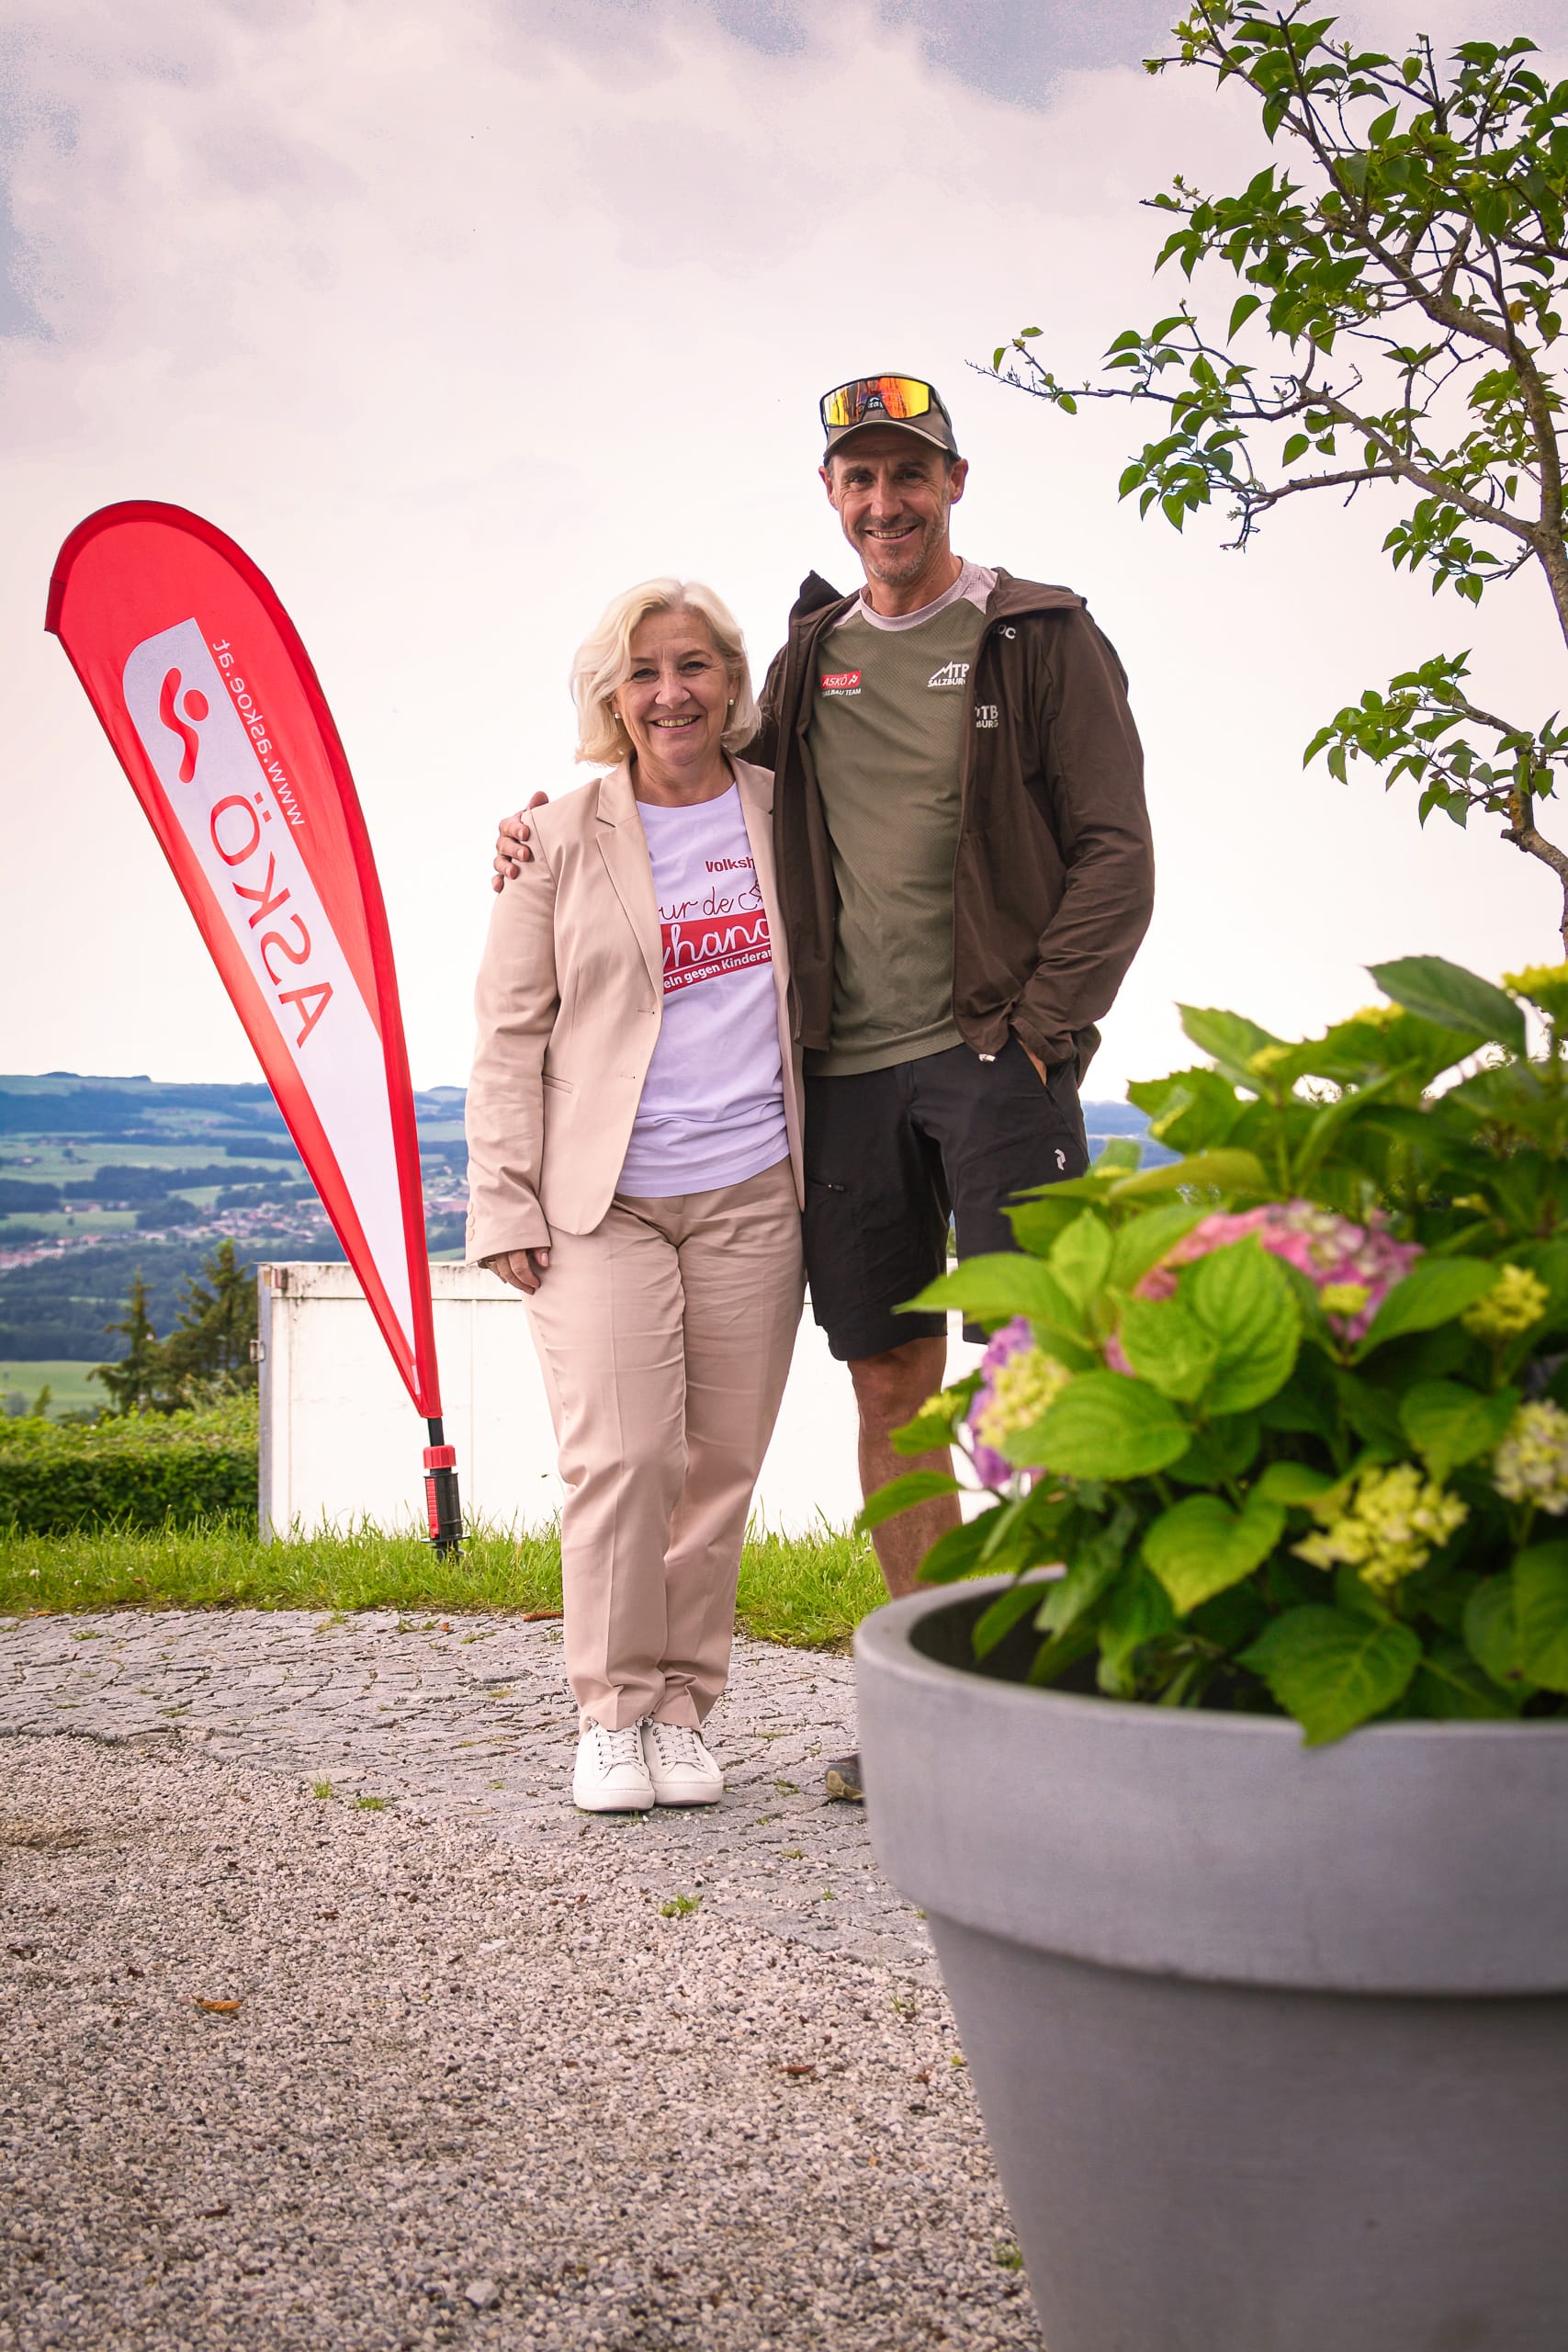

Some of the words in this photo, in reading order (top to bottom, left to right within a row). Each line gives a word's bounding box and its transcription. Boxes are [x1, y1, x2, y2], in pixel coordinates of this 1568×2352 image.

[822, 673, 848, 687] ASKÖ
[845, 687, 862, 696] TEAM
[658, 900, 698, 920] ur
[703, 886, 734, 916] de
[683, 964, 720, 984] gegen
